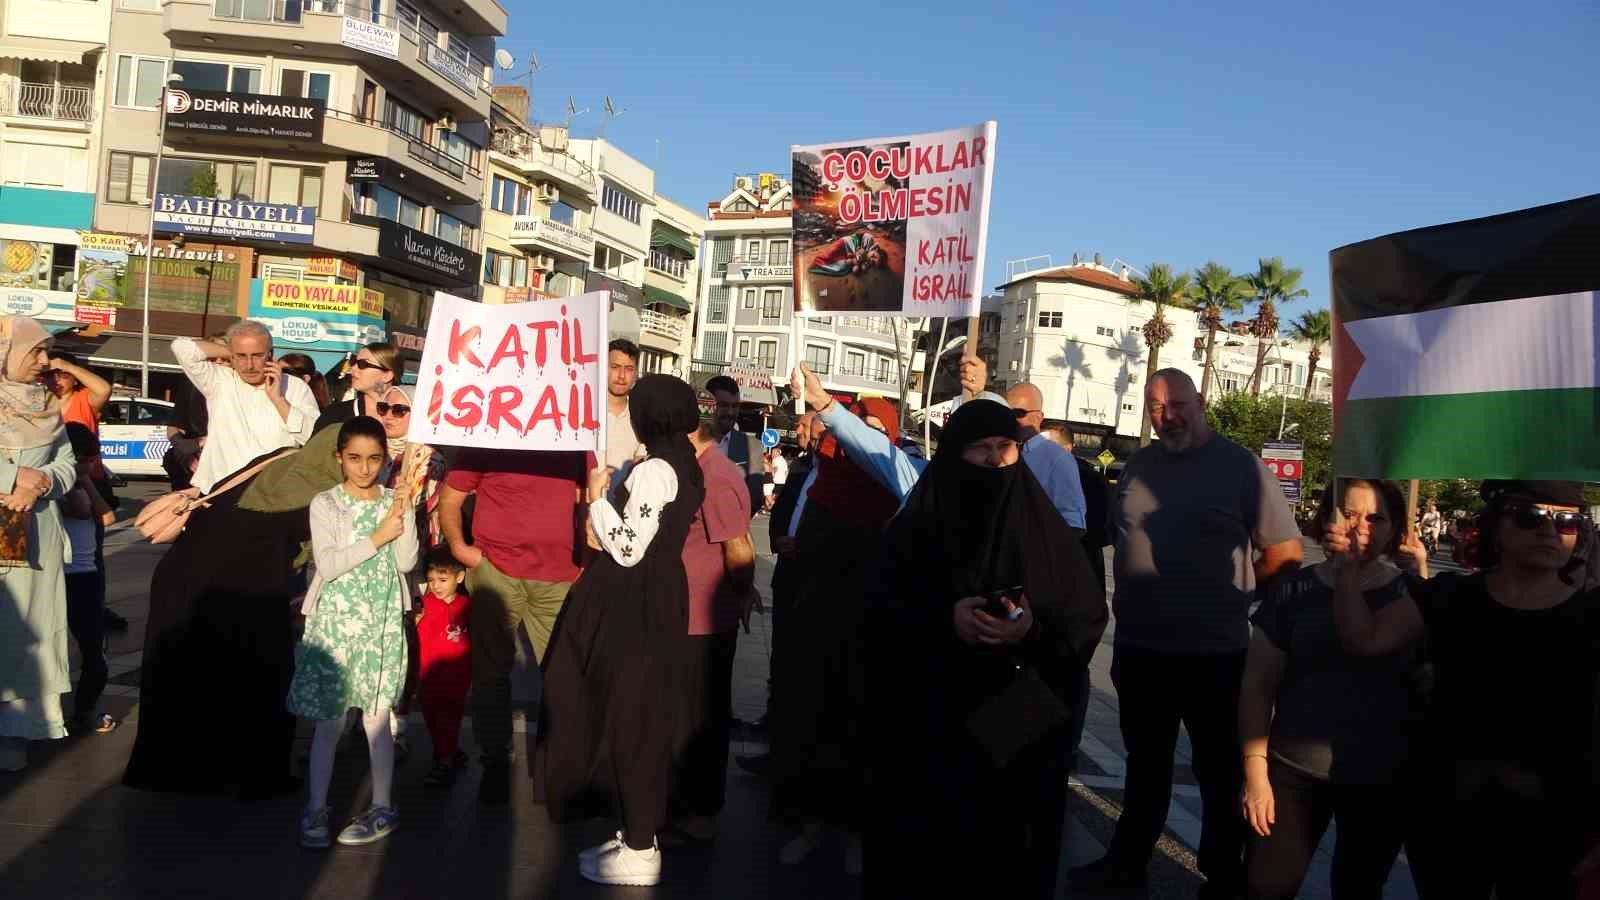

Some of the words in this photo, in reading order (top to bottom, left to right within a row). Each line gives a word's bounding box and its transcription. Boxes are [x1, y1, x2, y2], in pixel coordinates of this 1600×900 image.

[345, 18, 394, 41] BLUEWAY
[194, 97, 240, 114] DEMİR
[242, 99, 314, 120] MİMARLIK
[823, 136, 987, 191] ÇOCUKLAR
[160, 196, 304, 223] BAHRİYELİ
[839, 178, 972, 223] ÖLMESİN
[185, 225, 276, 239] www.bahriyeli.com
[225, 219, 297, 232] CHARTER
[513, 220, 537, 232] AVUKAT
[82, 235, 97, 243] GO
[918, 227, 974, 266] KATİL
[754, 267, 773, 276] TREA
[267, 283, 300, 300] FOTO
[304, 285, 357, 304] YAYLALI
[911, 265, 973, 304] İSRAİL
[282, 319, 318, 329] LOKUM
[282, 328, 317, 338] HOUSE
[448, 304, 598, 374] KATİL
[427, 364, 600, 437] İSRAİL
